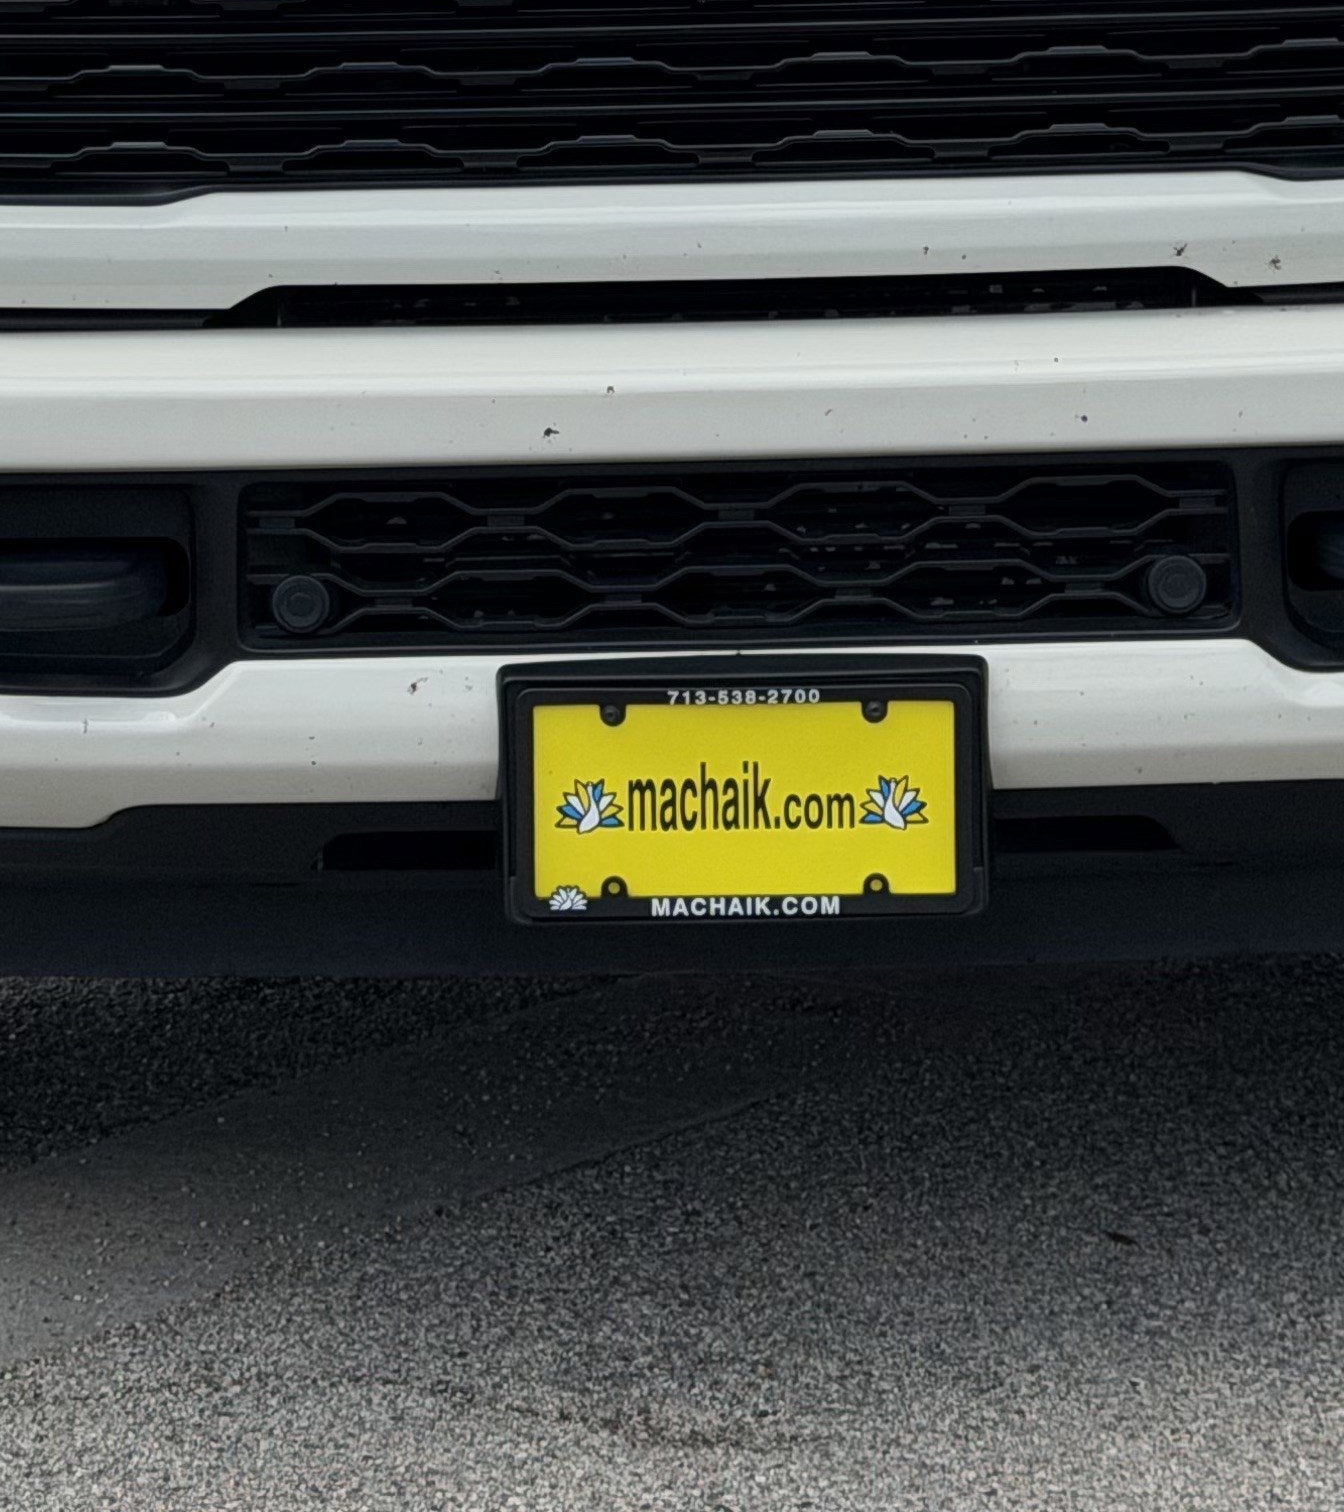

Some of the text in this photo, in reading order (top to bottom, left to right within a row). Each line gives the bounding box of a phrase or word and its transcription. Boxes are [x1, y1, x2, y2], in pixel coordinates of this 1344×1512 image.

[667, 689, 820, 705] 713-538-2700
[627, 761, 856, 831] machaik.com
[650, 896, 841, 917] MACHAIK.COM
